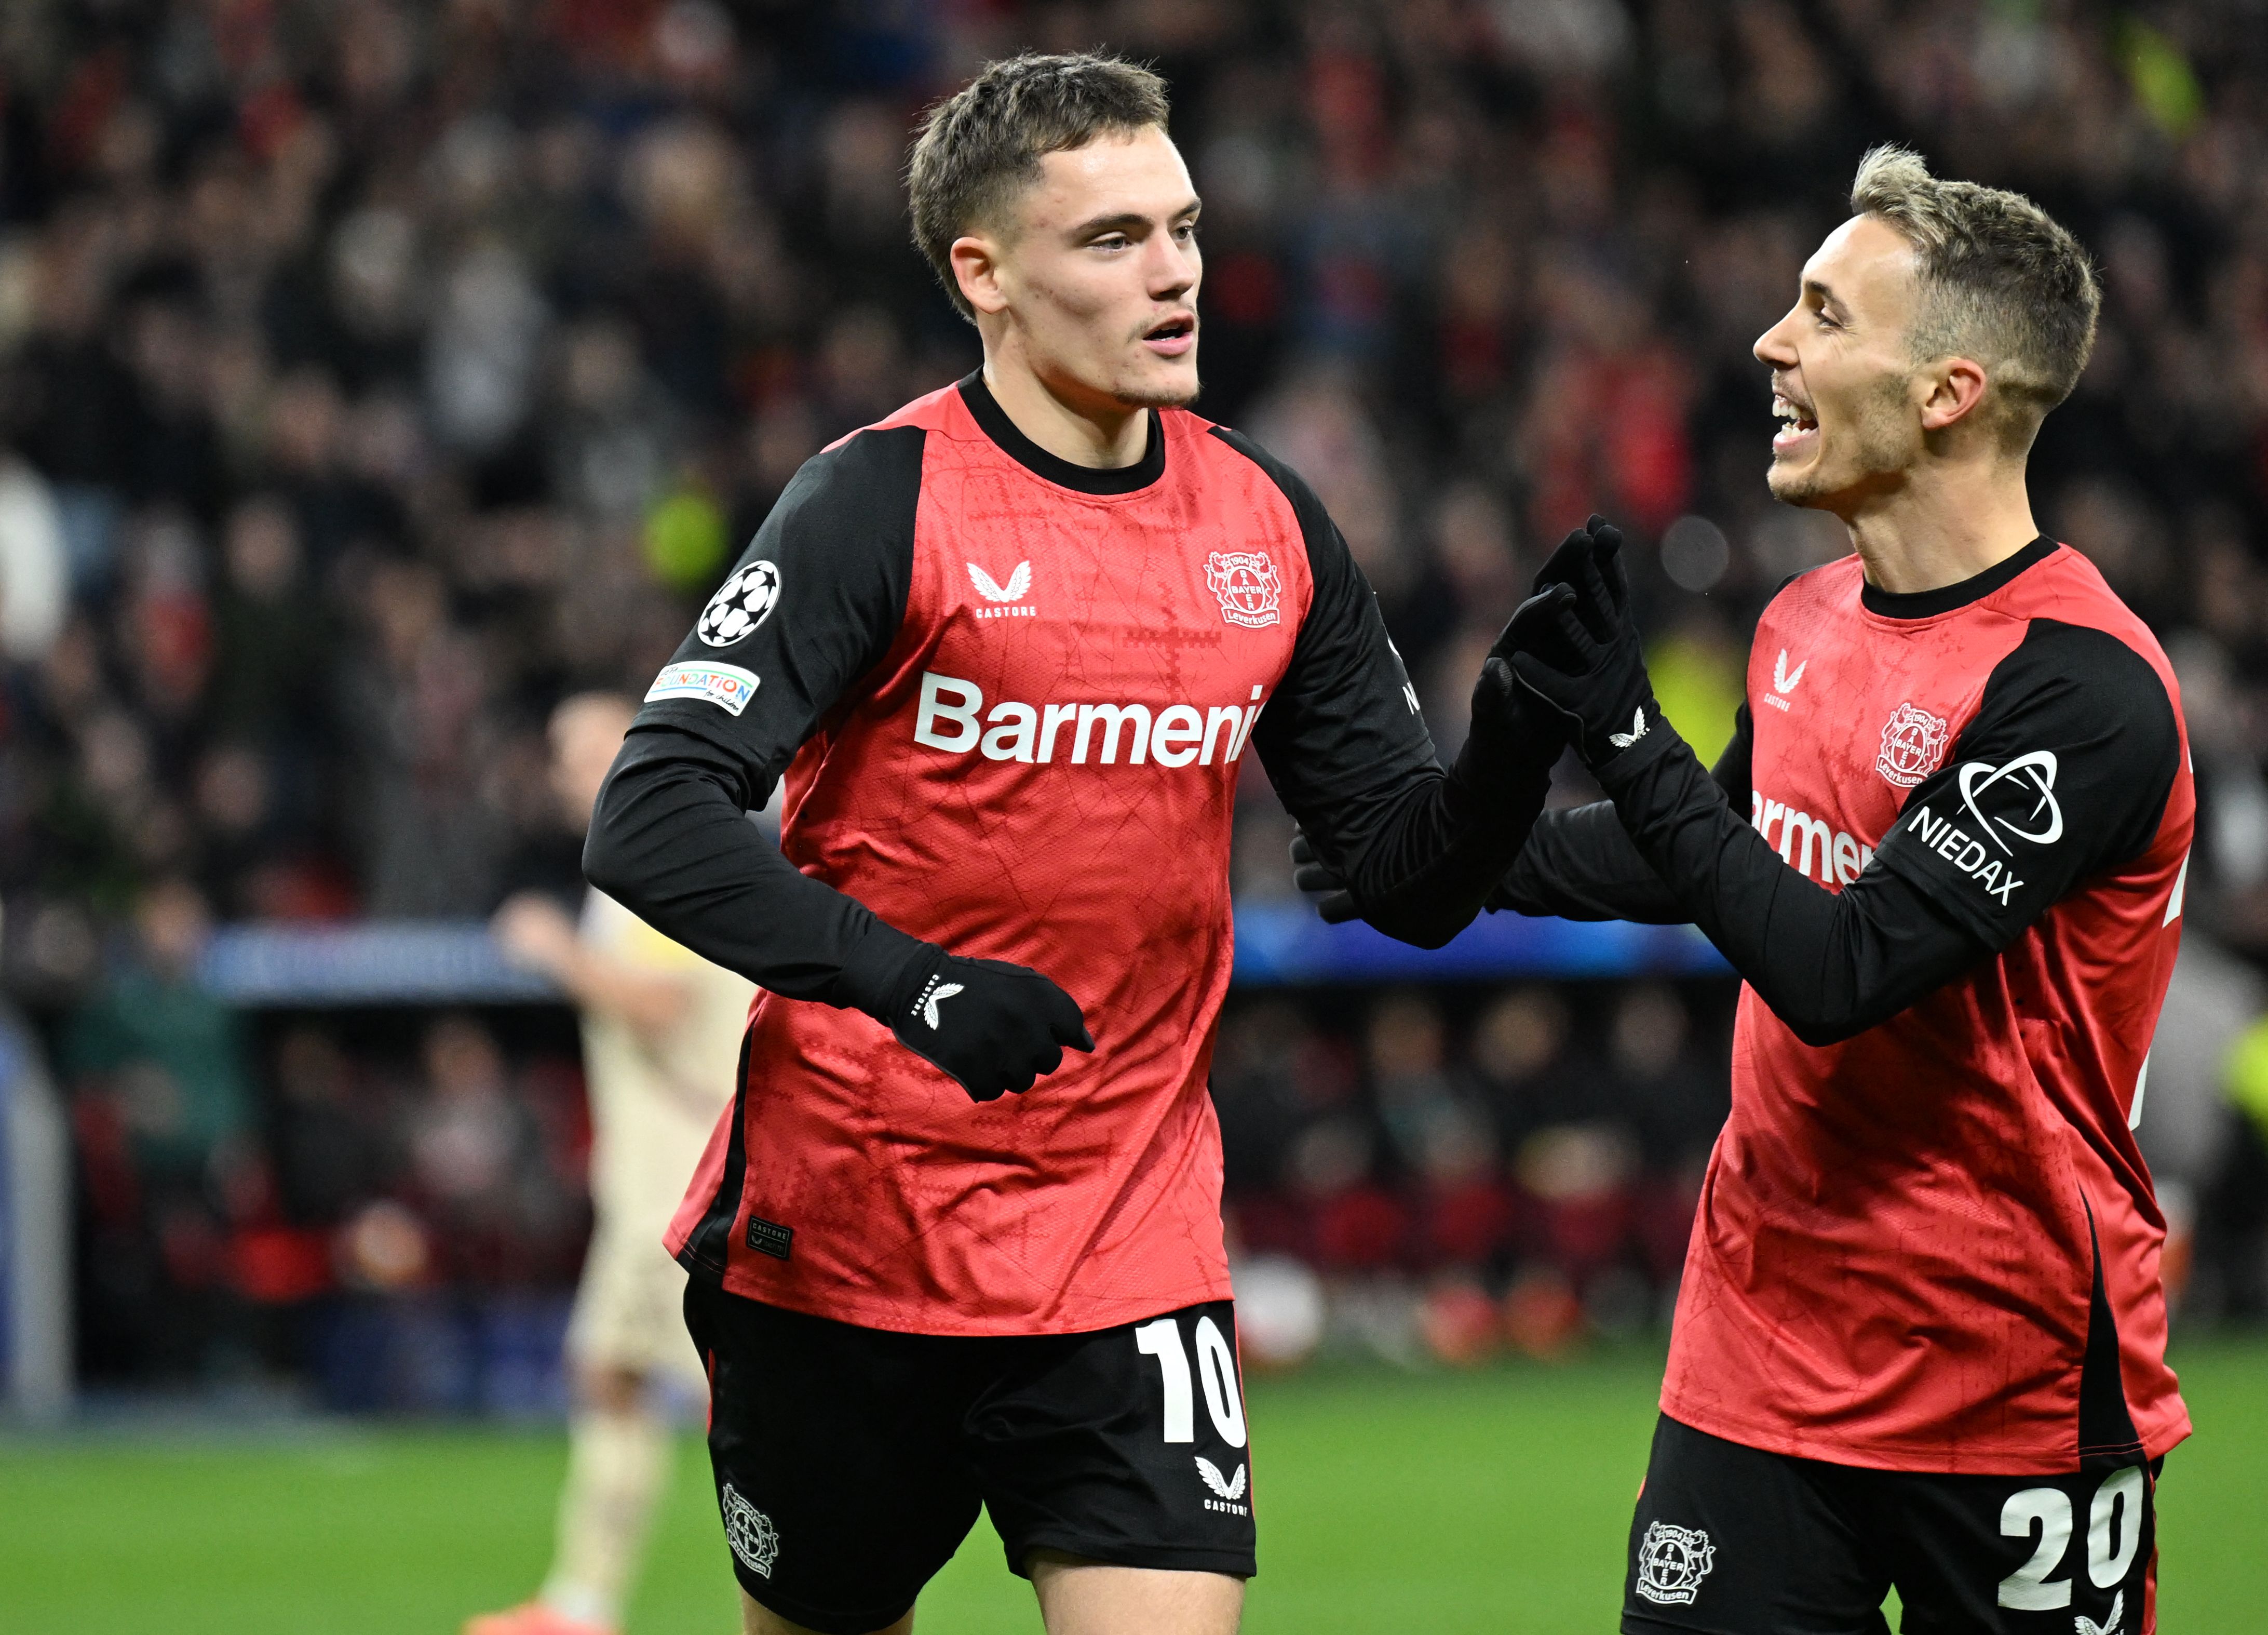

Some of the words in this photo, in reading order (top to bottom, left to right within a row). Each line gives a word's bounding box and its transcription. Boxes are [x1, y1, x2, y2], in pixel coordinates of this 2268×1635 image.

[1231, 557, 1249, 565] 1904
[1231, 586, 1262, 594] BAYER
[976, 606, 1036, 618] CASTORE
[1227, 610, 1276, 624] Leverkusen
[716, 694, 739, 712] children
[1914, 714, 1928, 725] 1904
[1896, 739, 1922, 757] BAYER
[1879, 759, 1923, 784] Leverkusen
[1908, 806, 2024, 906] NIEDAX
[911, 974, 939, 1016] CASTORE
[753, 1223, 786, 1239] CASTORE
[1135, 1316, 1247, 1448] 10
[1665, 1530, 1683, 1540] 1904
[1997, 1465, 2143, 1611] 20
[1653, 1558, 1684, 1572] BAYER
[1640, 1581, 1689, 1600] Leverkusen
